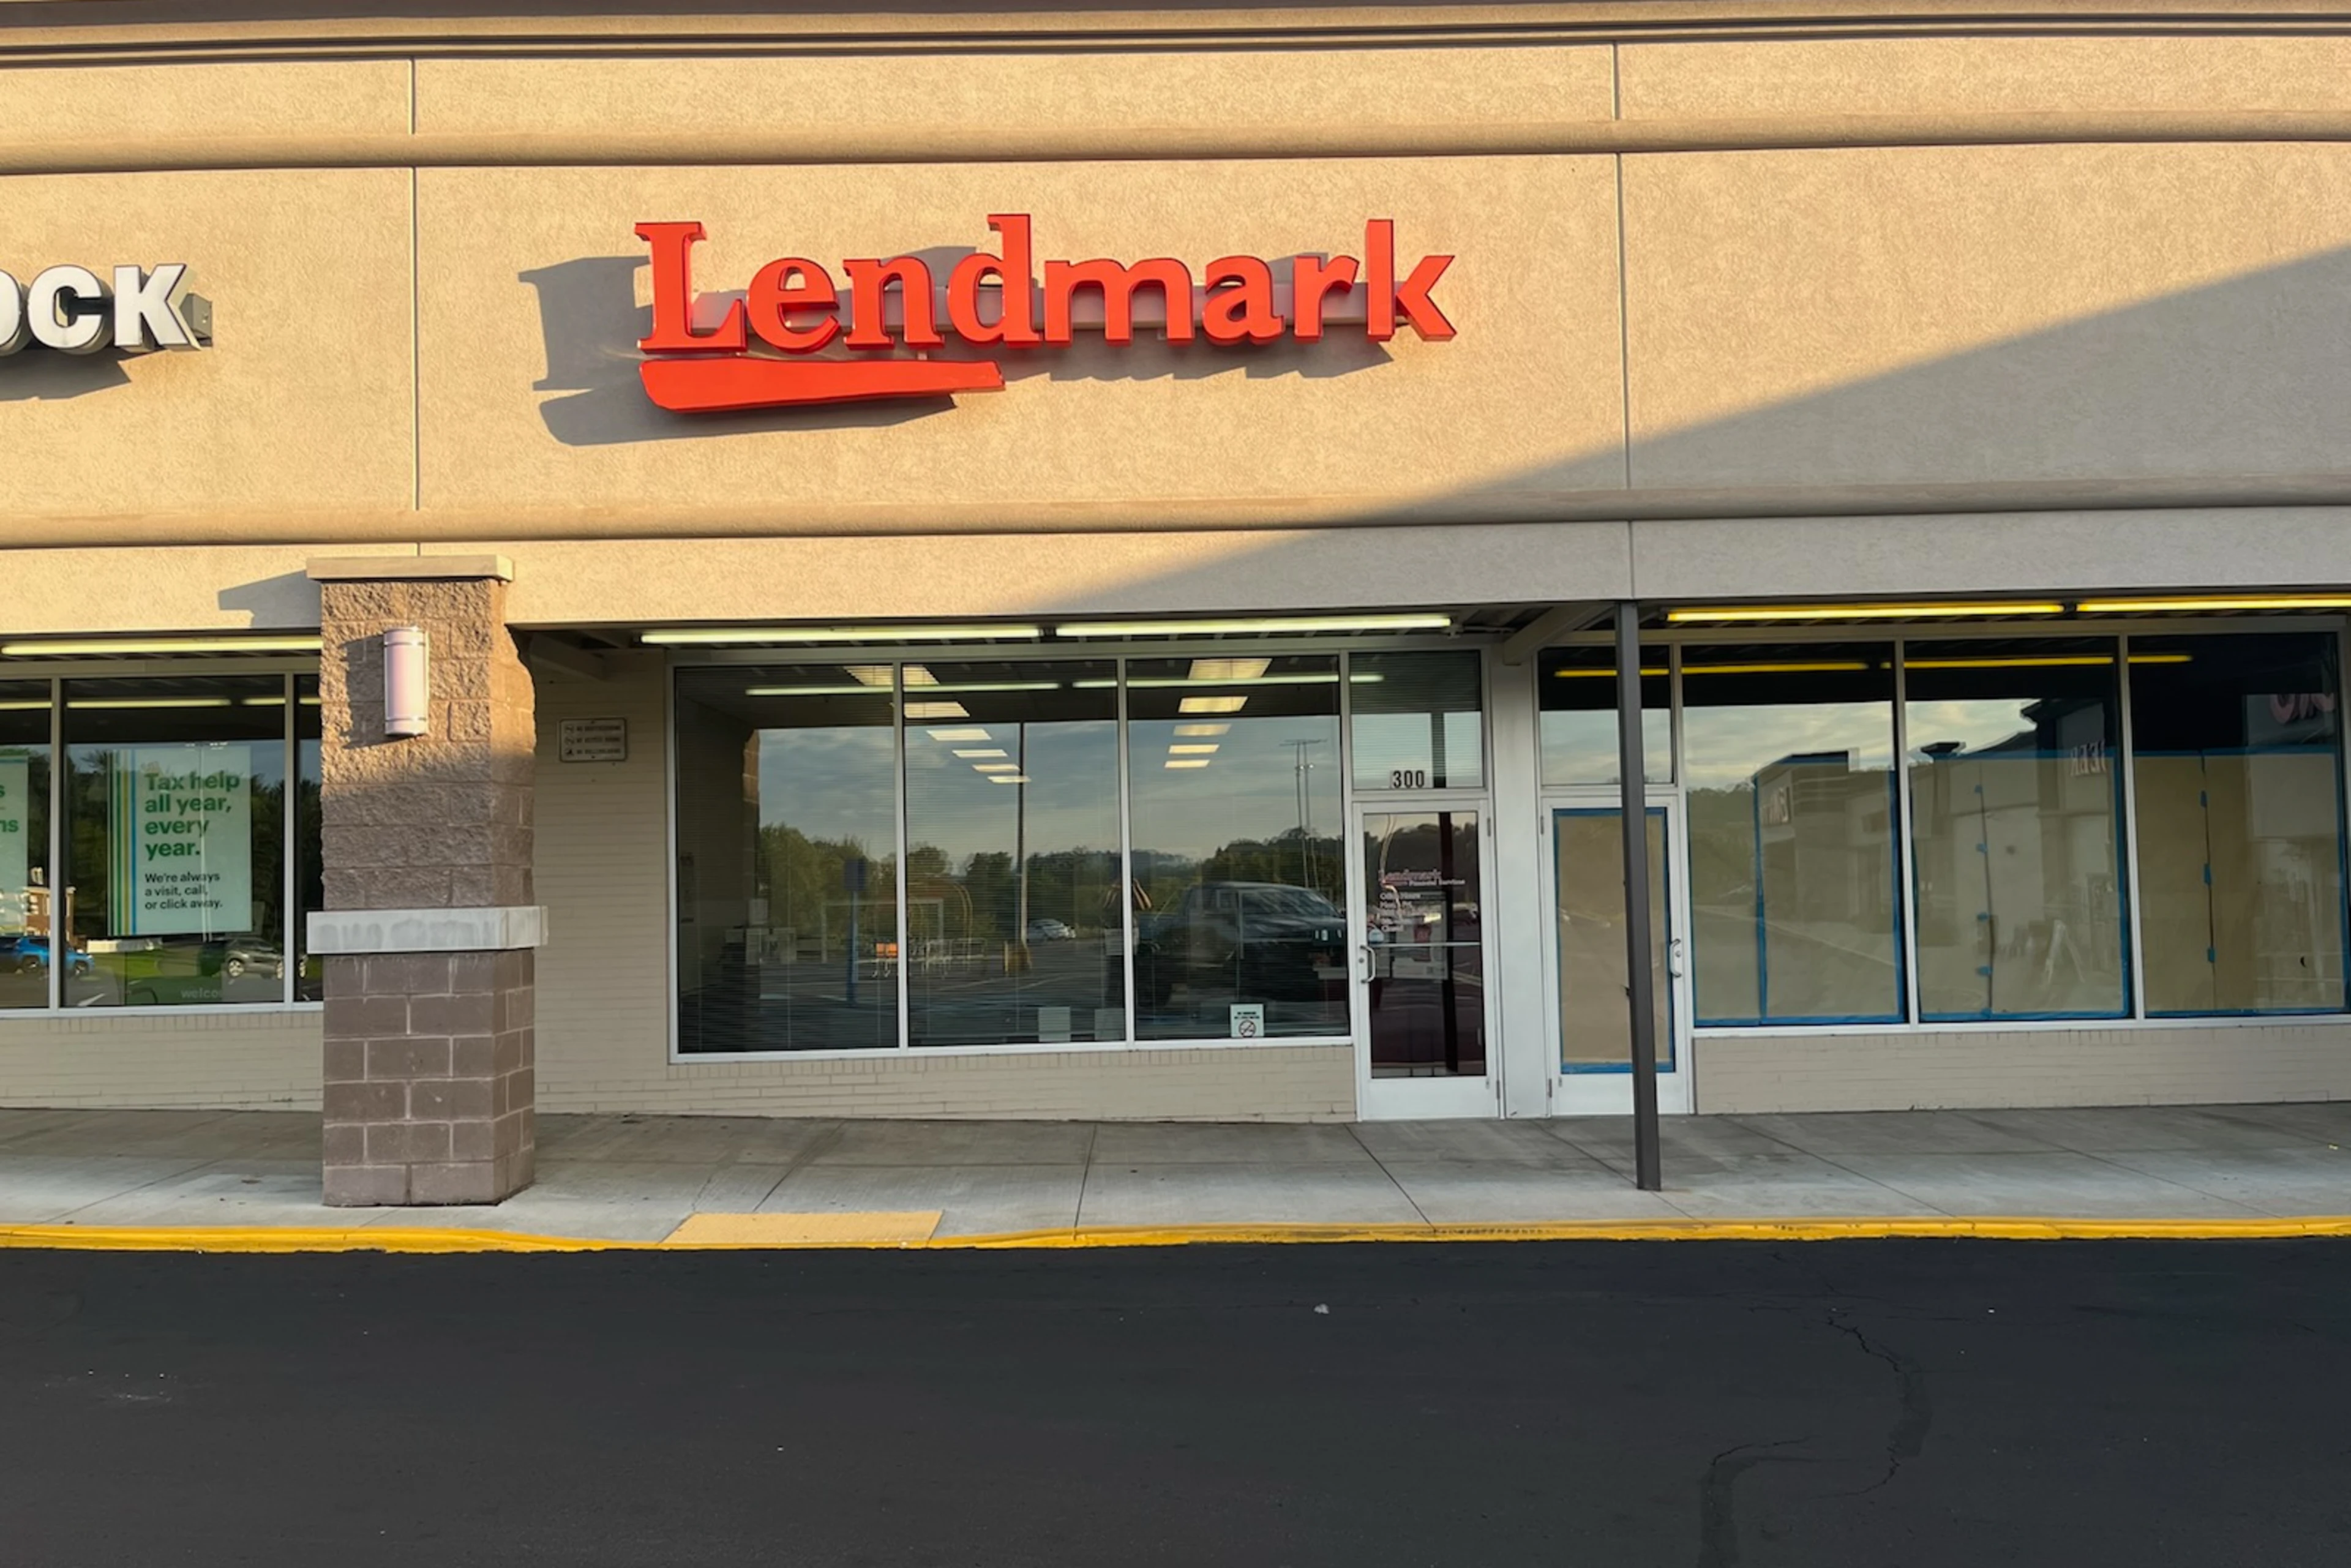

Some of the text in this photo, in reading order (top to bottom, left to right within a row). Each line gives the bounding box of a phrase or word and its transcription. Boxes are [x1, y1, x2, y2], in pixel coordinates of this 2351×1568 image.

[634, 213, 1457, 355] Lendmark
[0, 263, 197, 352] CK
[144, 770, 240, 792] Tax help
[1393, 770, 1424, 789] 300
[144, 793, 231, 816] all year,
[144, 820, 209, 838] every
[144, 842, 200, 861] year.
[144, 871, 220, 883] We're always
[154, 886, 182, 896] visit,
[160, 899, 187, 909] click
[190, 899, 223, 910] away.
